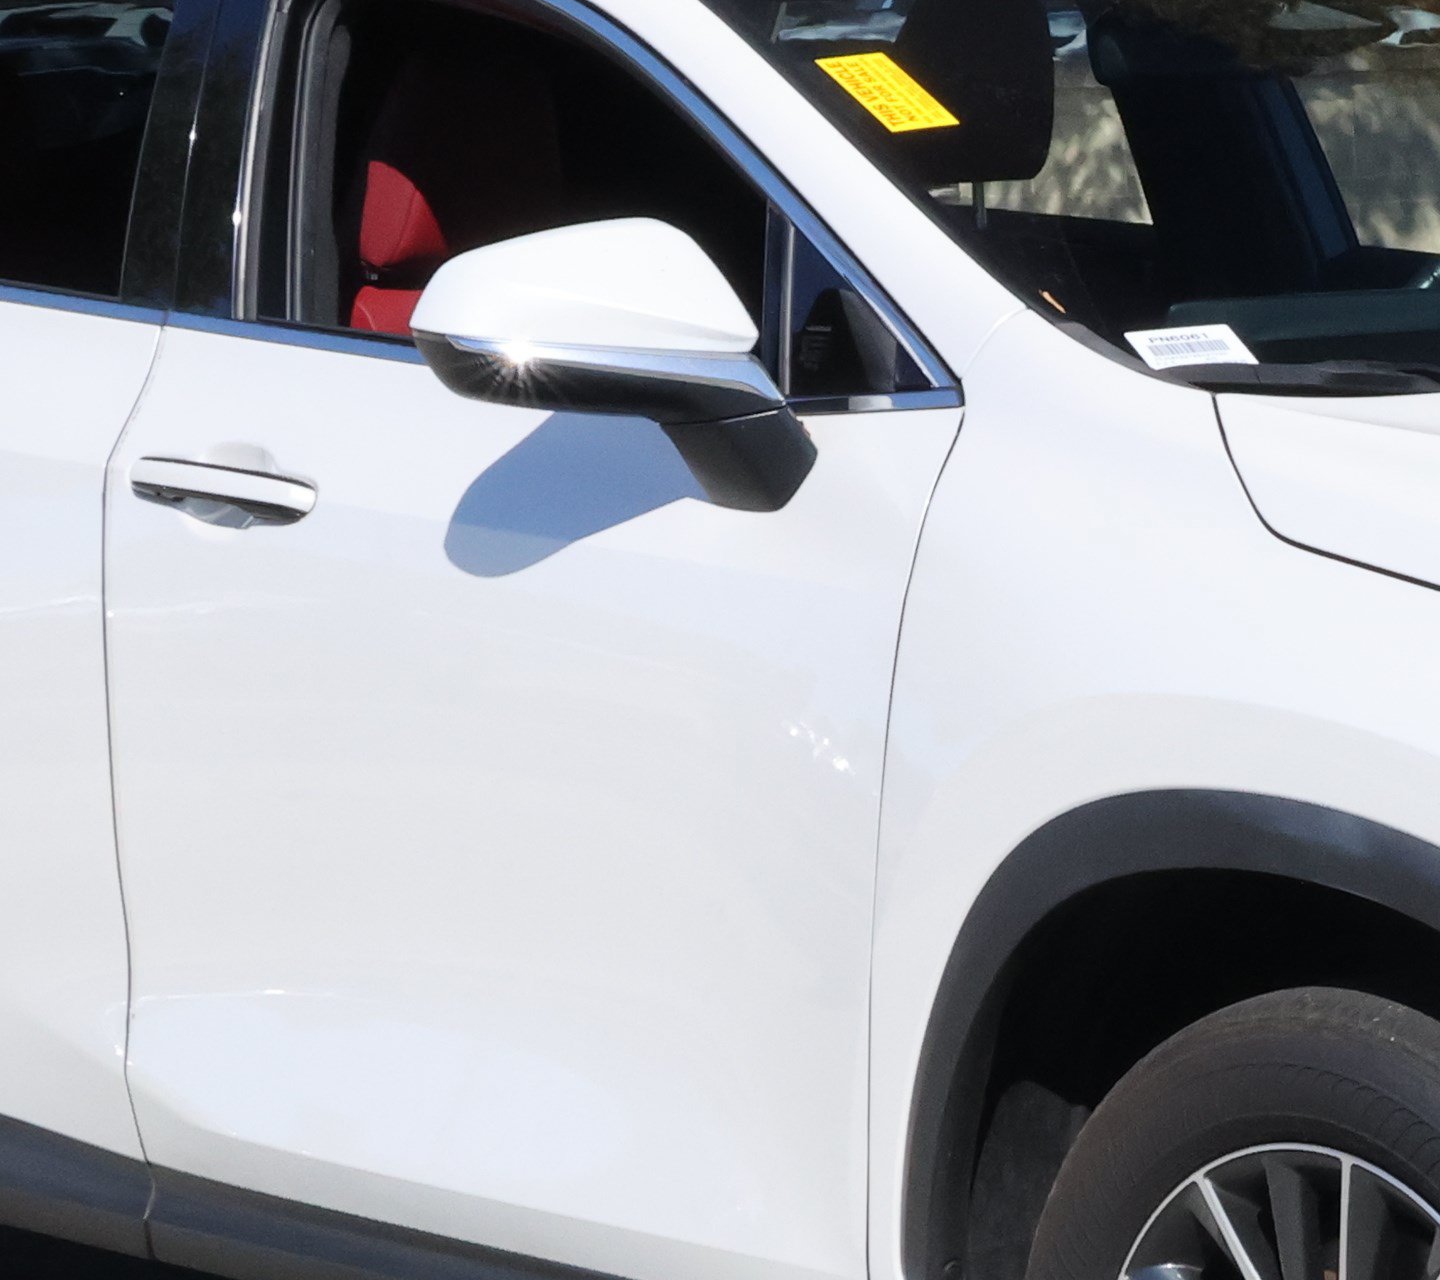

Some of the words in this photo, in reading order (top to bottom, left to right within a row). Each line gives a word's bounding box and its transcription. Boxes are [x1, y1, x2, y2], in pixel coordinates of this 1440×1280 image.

[826, 61, 877, 103] VEHICLE
[846, 61, 876, 83] SALE
[874, 85, 897, 103] FOR
[873, 104, 905, 127] THIS
[894, 104, 919, 122] NOT
